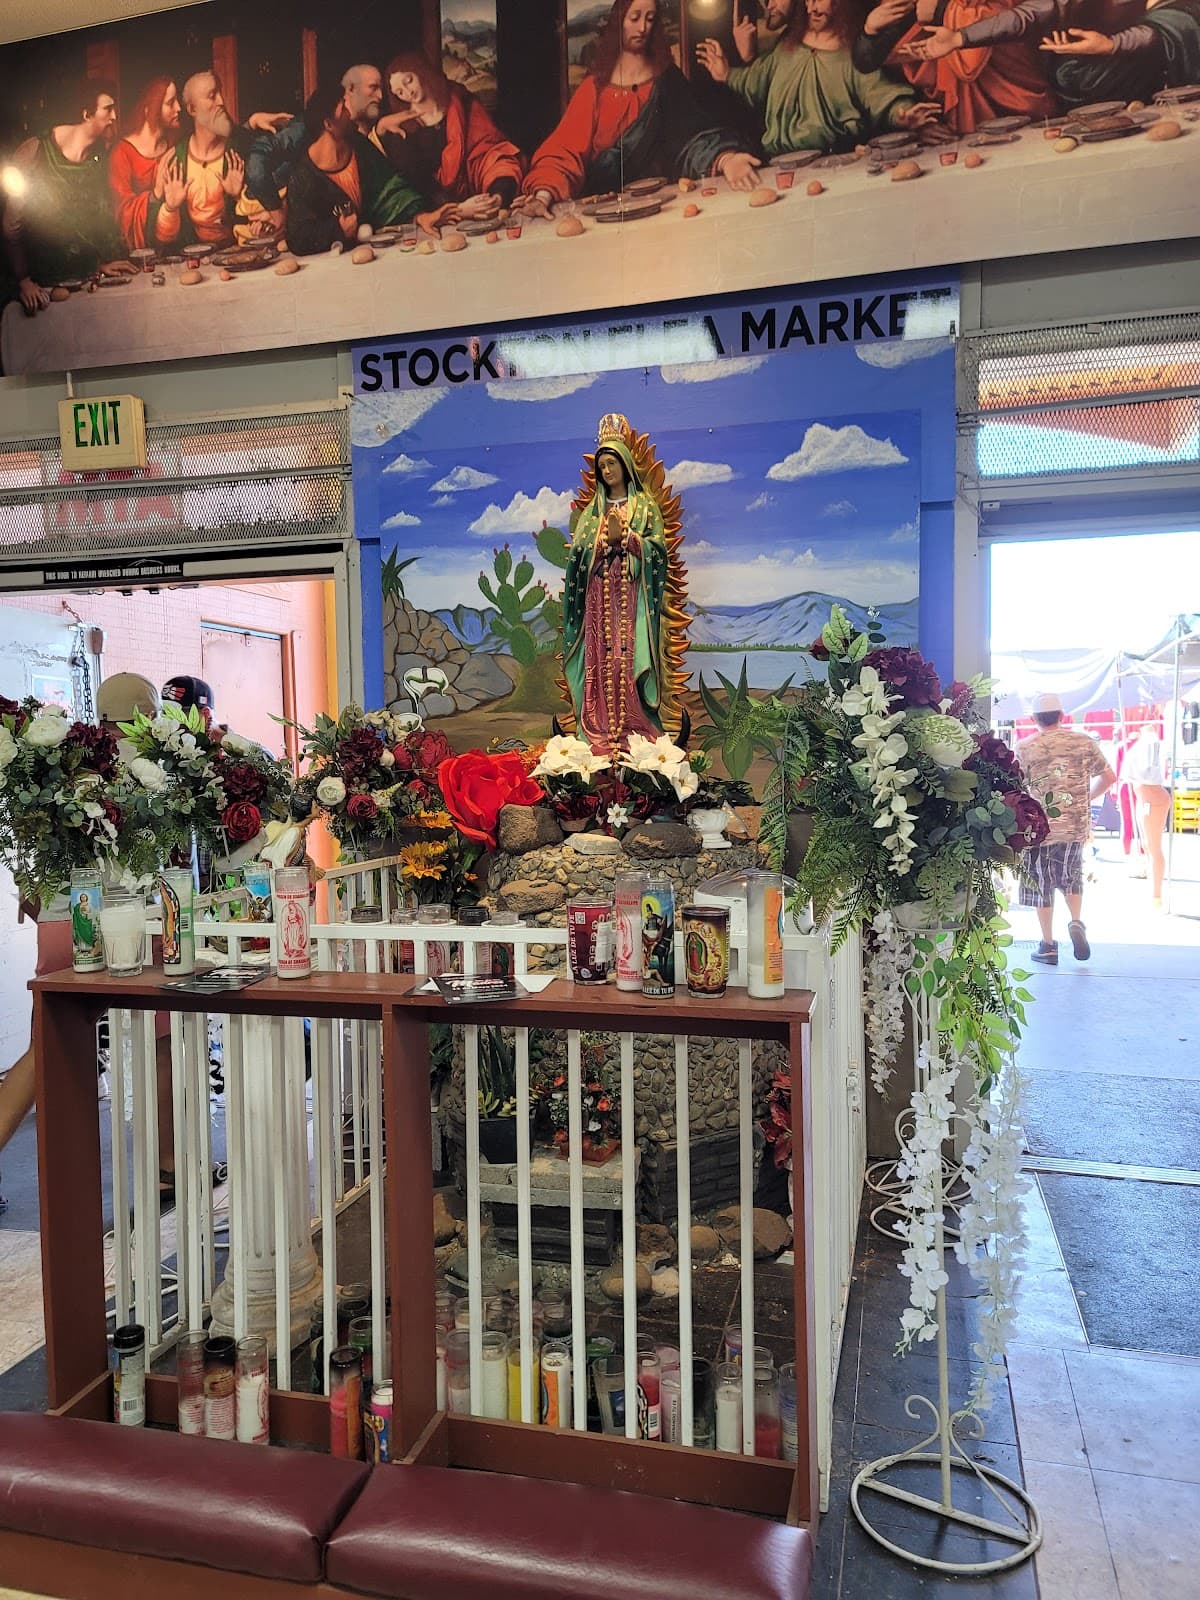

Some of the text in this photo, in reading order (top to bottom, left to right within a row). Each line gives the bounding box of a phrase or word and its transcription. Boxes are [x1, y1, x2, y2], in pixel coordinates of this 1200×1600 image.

[360, 330, 590, 392] STOCK
[73, 400, 121, 448] EXIT
[71, 571, 78, 579] TO
[569, 925, 576, 936] TU
[570, 937, 577, 948] DE
